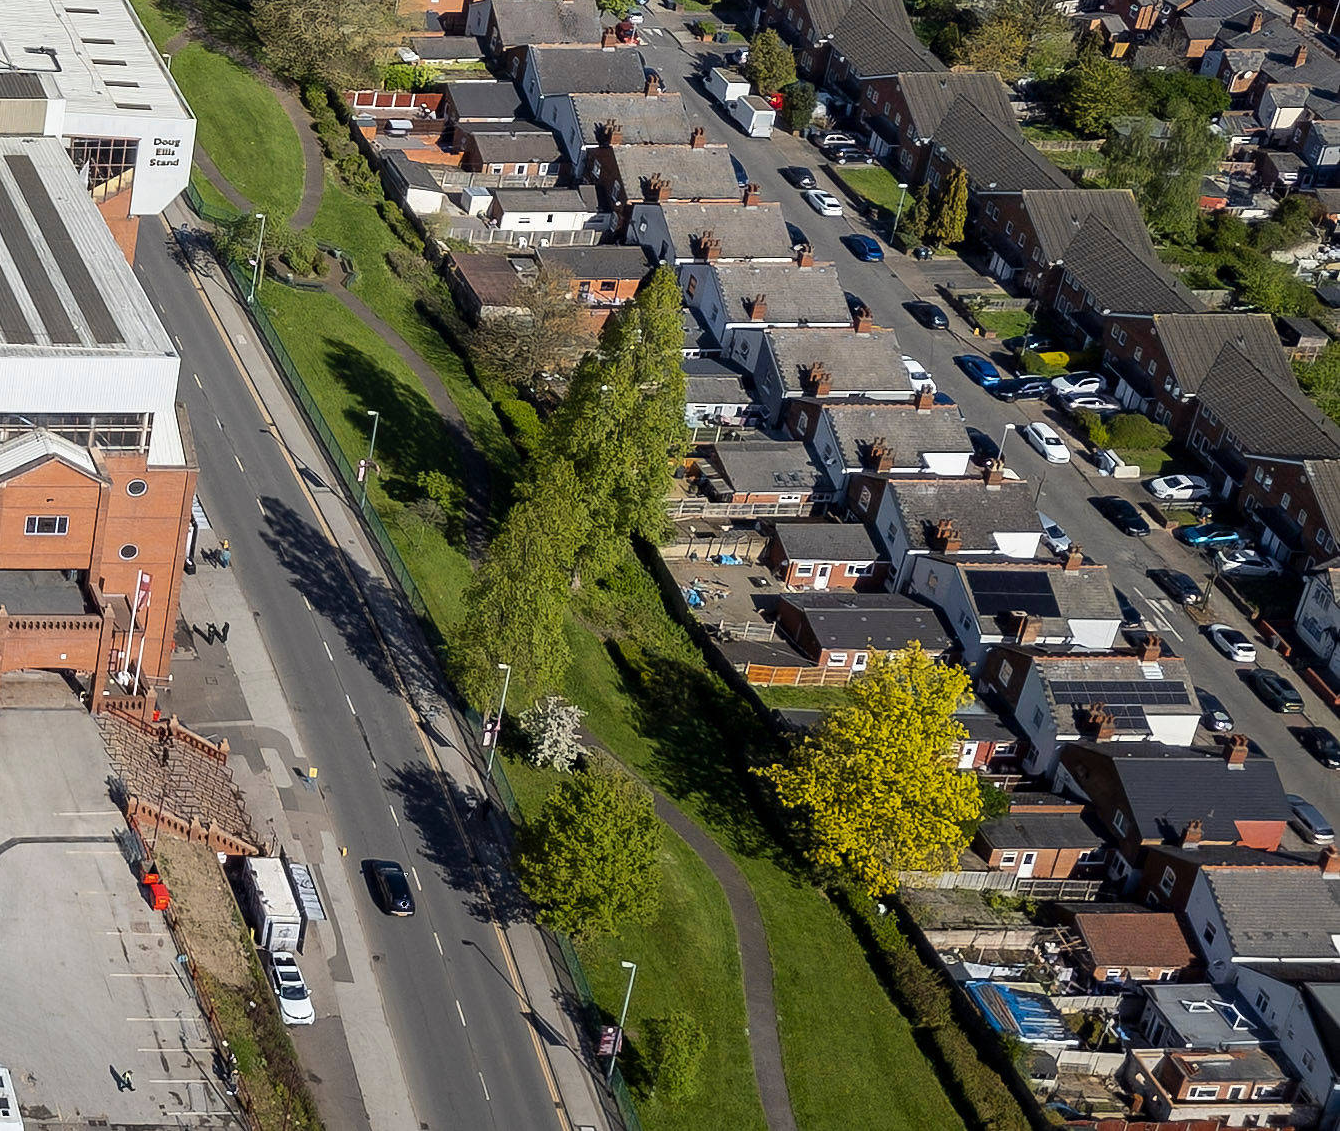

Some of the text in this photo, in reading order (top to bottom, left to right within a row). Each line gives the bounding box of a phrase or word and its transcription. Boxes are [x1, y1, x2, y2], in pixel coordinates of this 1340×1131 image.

[153, 138, 181, 147] Doug
[155, 148, 176, 156] Ellis
[149, 158, 180, 167] Stand
